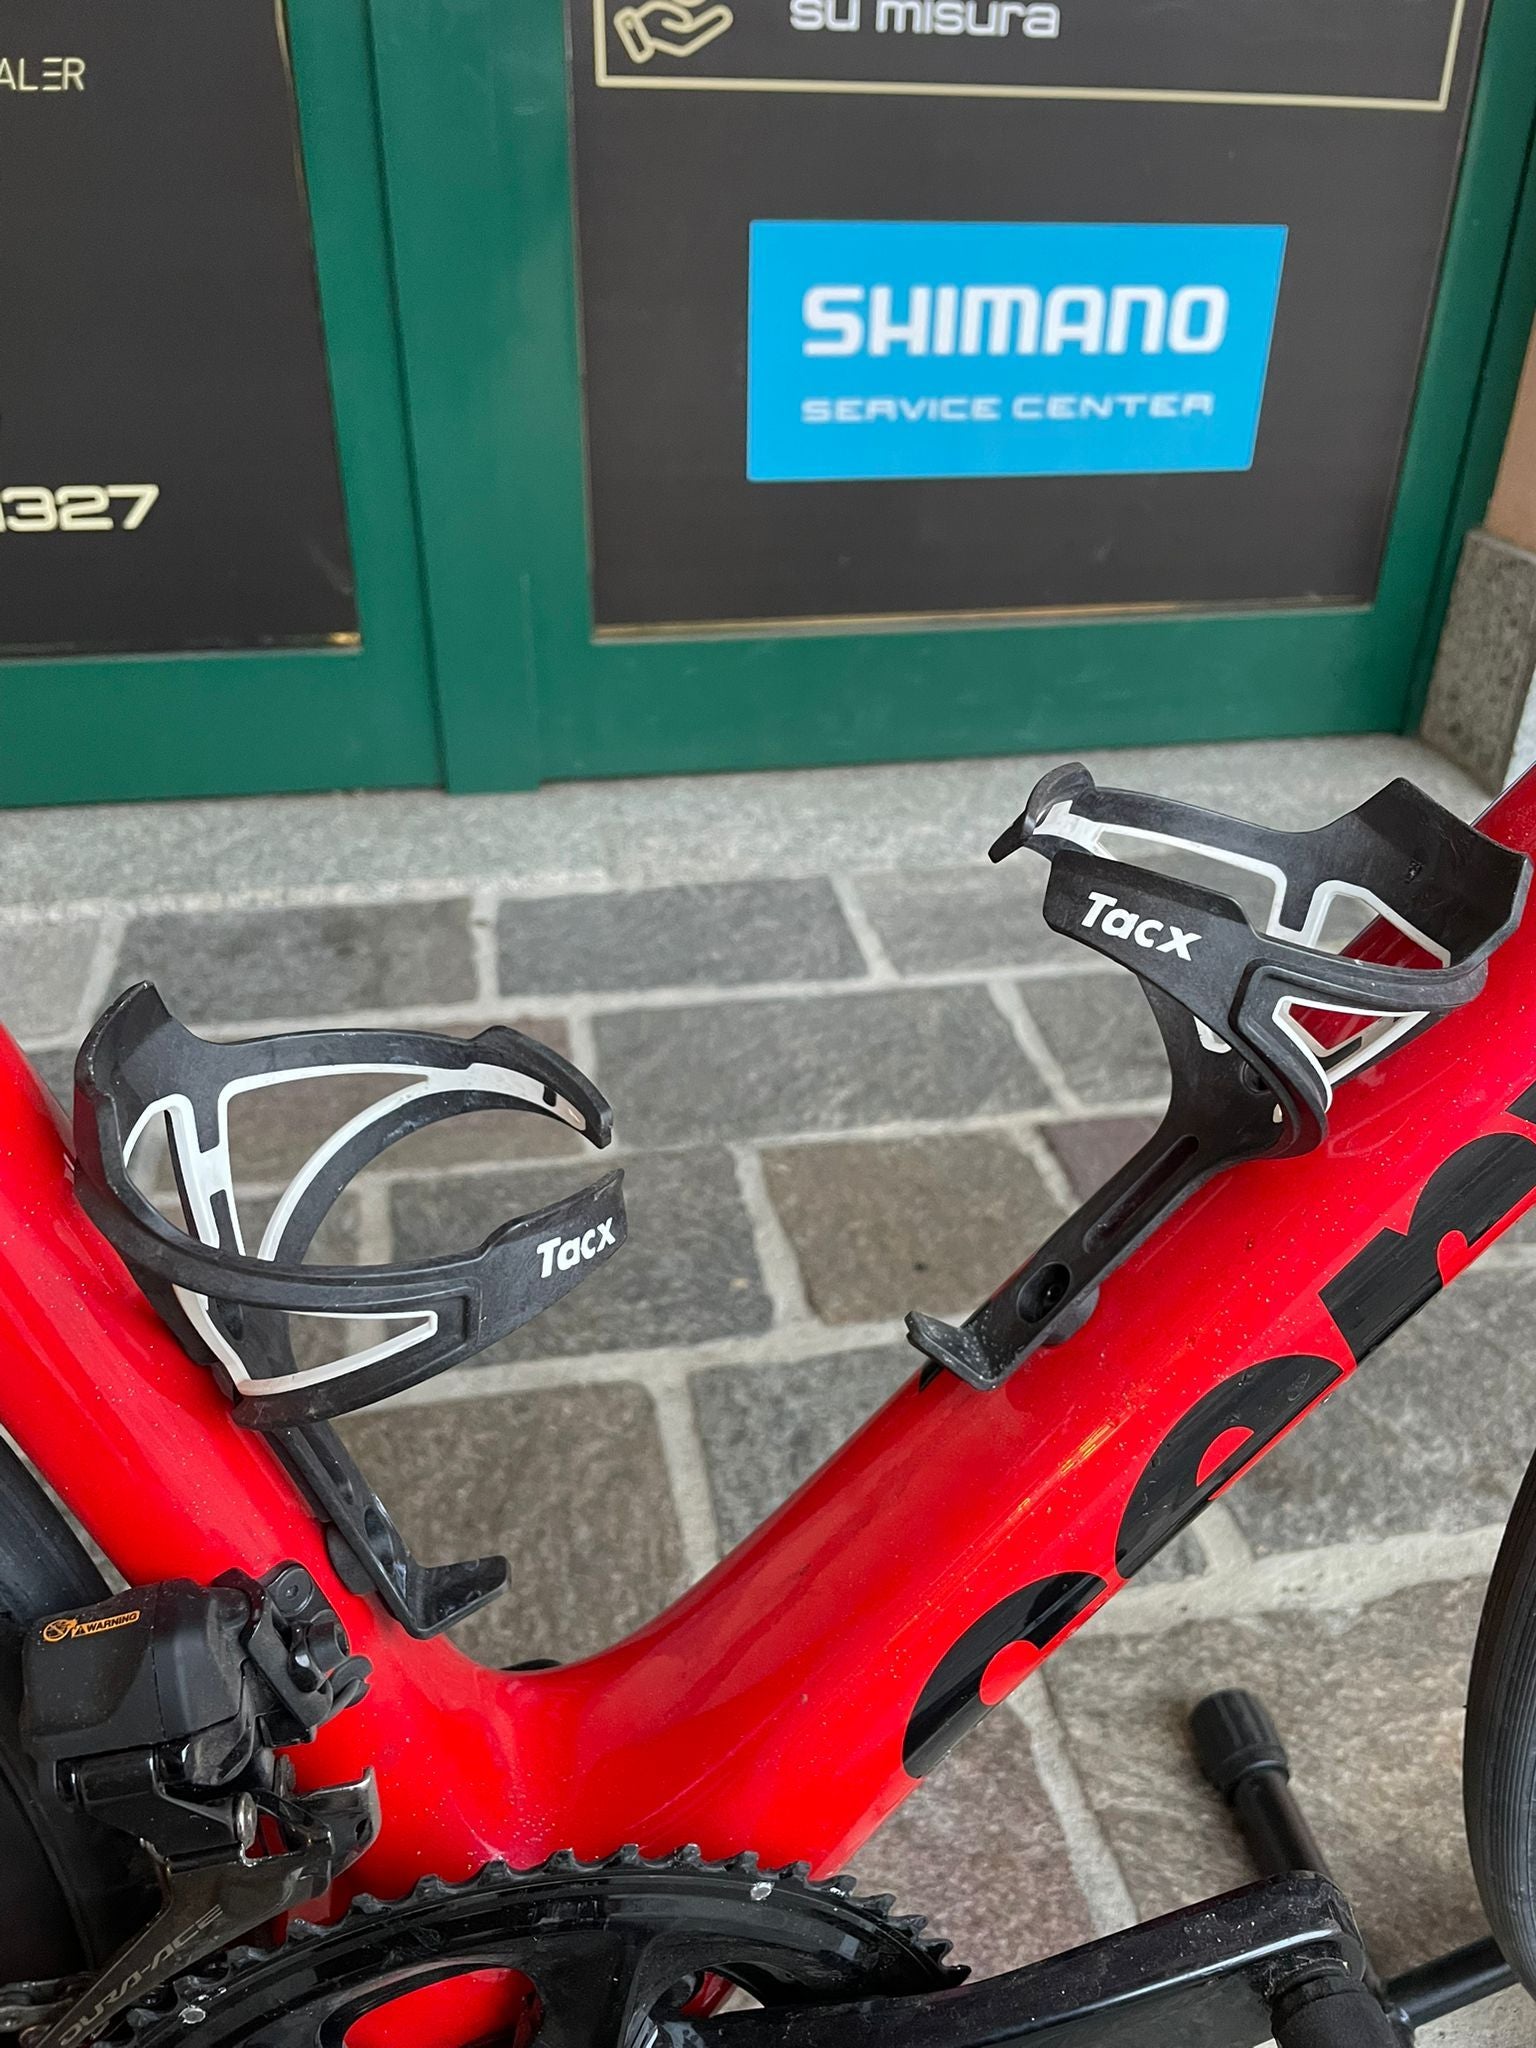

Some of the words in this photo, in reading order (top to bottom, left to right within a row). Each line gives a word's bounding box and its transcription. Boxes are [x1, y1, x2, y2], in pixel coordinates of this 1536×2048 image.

[789, 0, 861, 32] su
[875, 0, 1061, 39] misura
[802, 284, 1229, 357] SHIMANO
[801, 395, 1003, 423] SERVICE
[1011, 390, 1216, 419] CENTER
[0, 484, 160, 533] 327
[1081, 891, 1203, 961] Tacx
[536, 1216, 617, 1279] Tacx
[87, 1612, 138, 1633] WARNING
[58, 1903, 224, 2046] DURA-ACE
